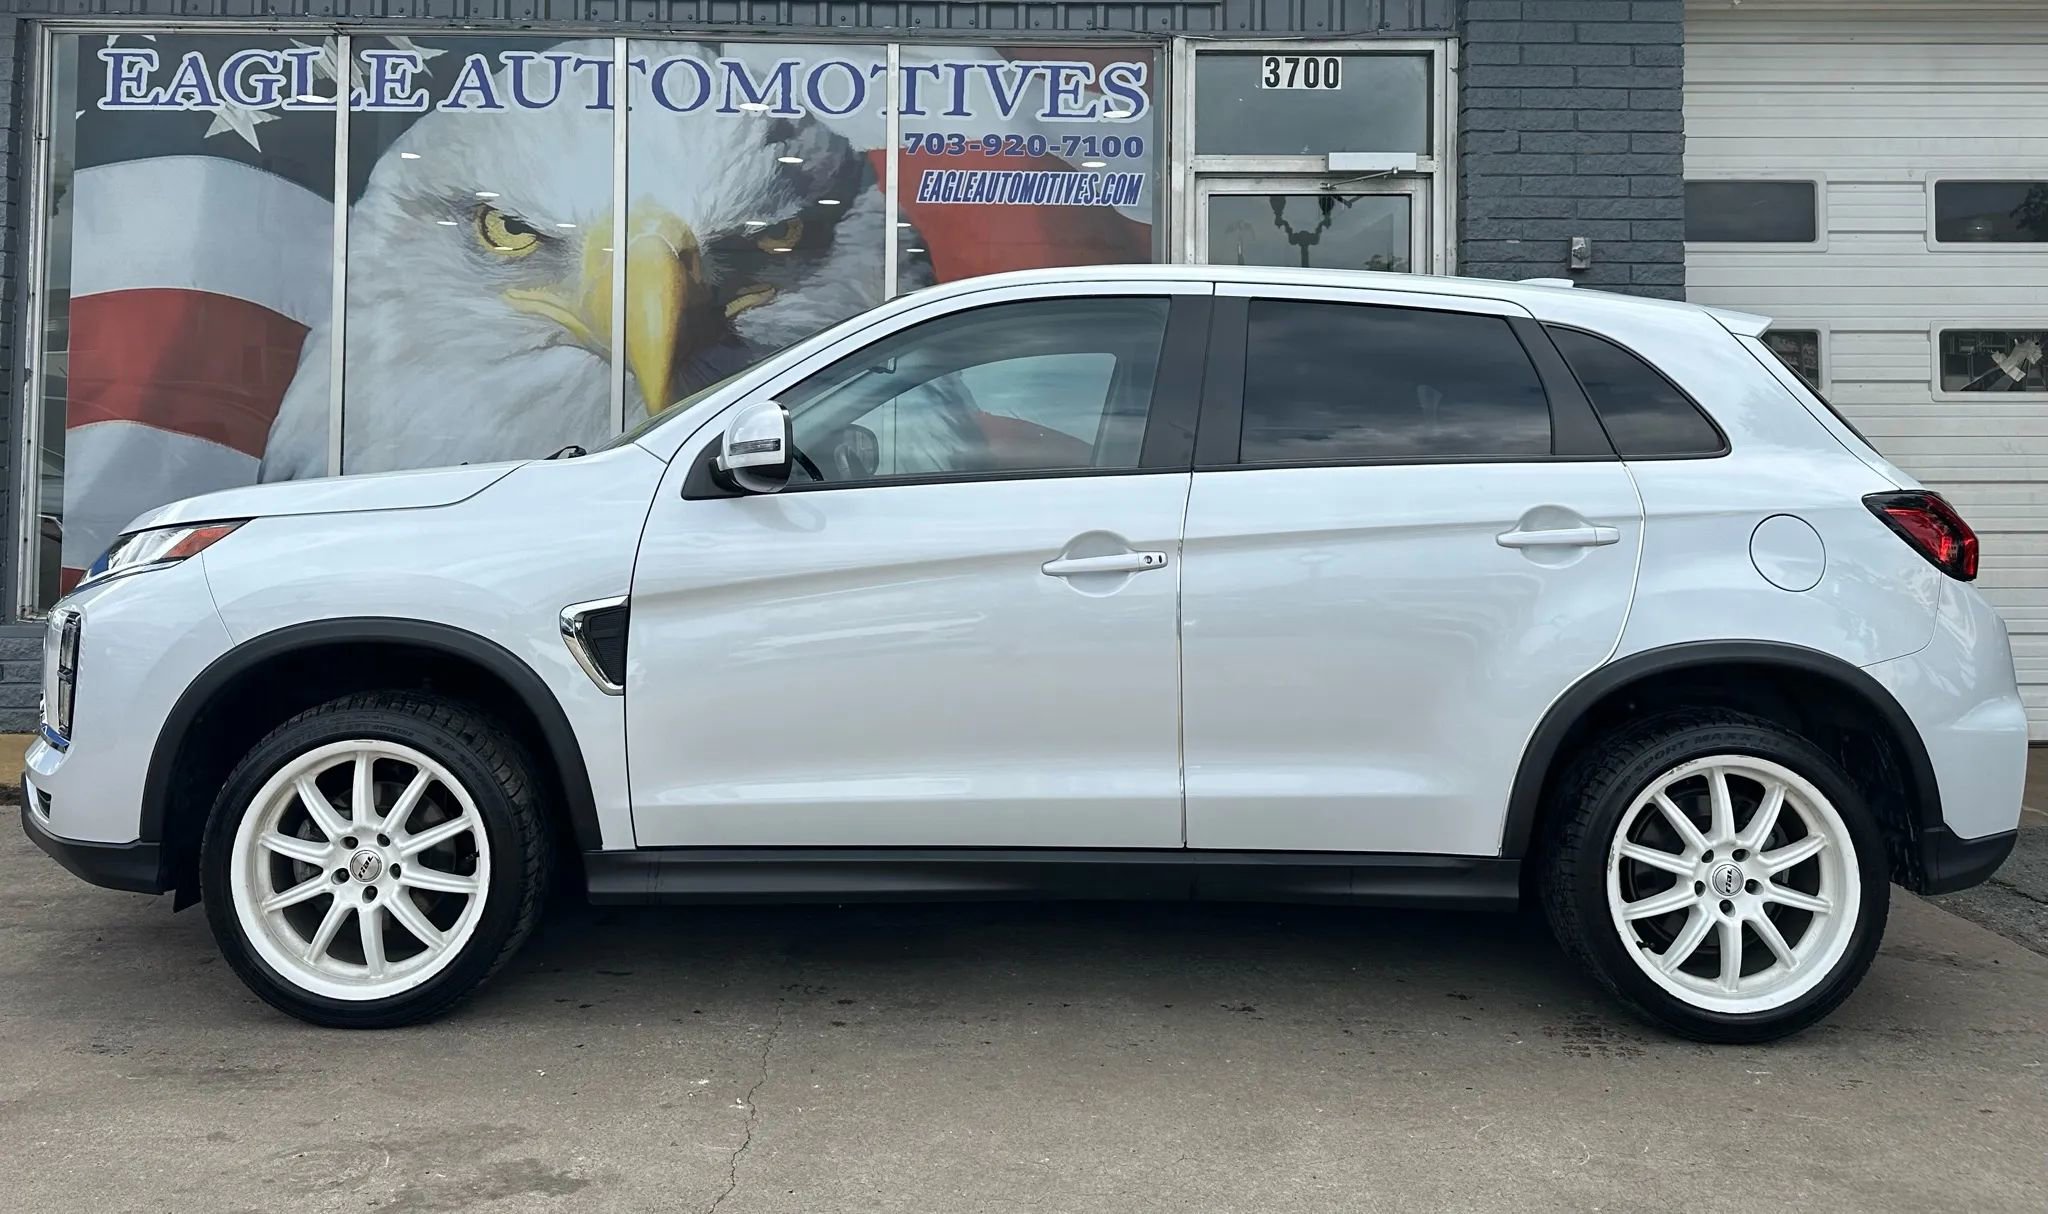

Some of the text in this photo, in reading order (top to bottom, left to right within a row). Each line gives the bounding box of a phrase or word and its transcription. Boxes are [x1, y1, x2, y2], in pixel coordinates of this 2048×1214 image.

[98, 48, 1151, 119] EAGLE AUTOMOTIVES
[1264, 56, 1340, 89] 3700
[904, 132, 1145, 158] 703-920-7100
[916, 169, 1146, 207] EAGLEAUTOMOTIVES.COM
[1636, 740, 1688, 773] SPORT
